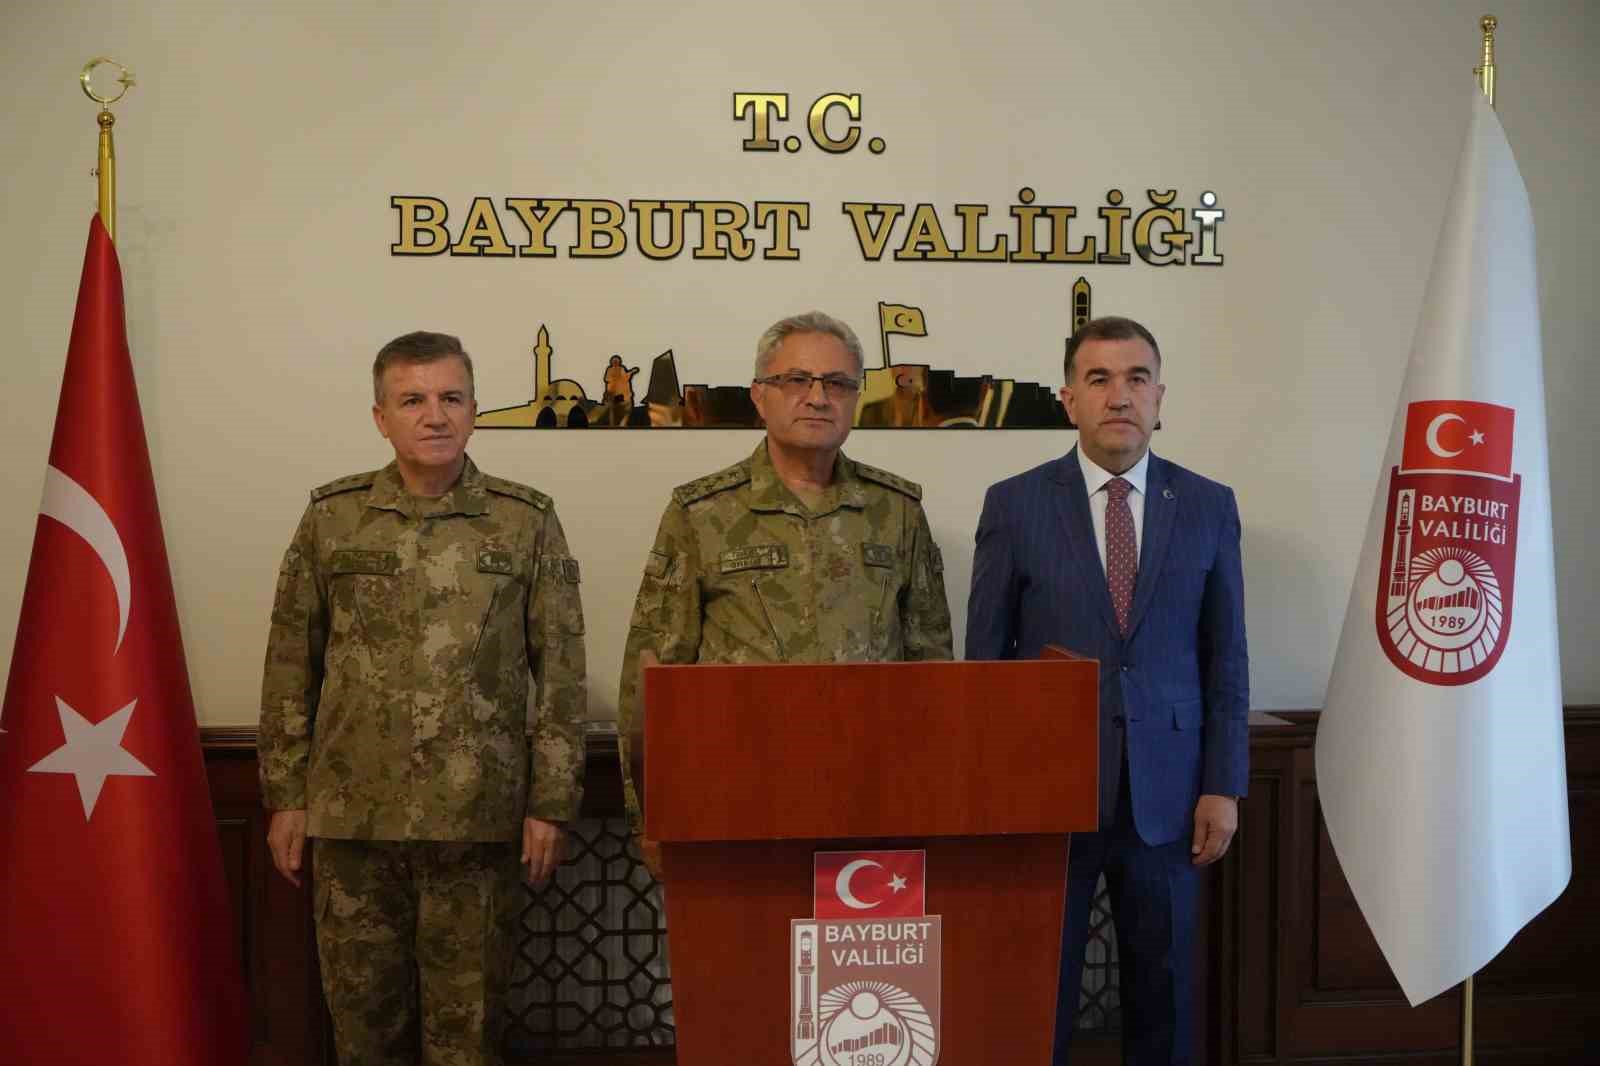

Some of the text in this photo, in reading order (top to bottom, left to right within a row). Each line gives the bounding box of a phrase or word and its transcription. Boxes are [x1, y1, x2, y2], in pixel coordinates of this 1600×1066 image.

[733, 92, 887, 154] T.C.
[390, 187, 1225, 266] BAYBURT VALİLİĞİ
[1421, 494, 1509, 521] BAYBURT
[1418, 518, 1507, 545] VALİLİĞİ
[1431, 615, 1466, 630] 1989
[825, 922, 932, 943] BAYBURT
[831, 943, 924, 967] VALİLİĞİ
[848, 1053, 885, 1066] 1989
